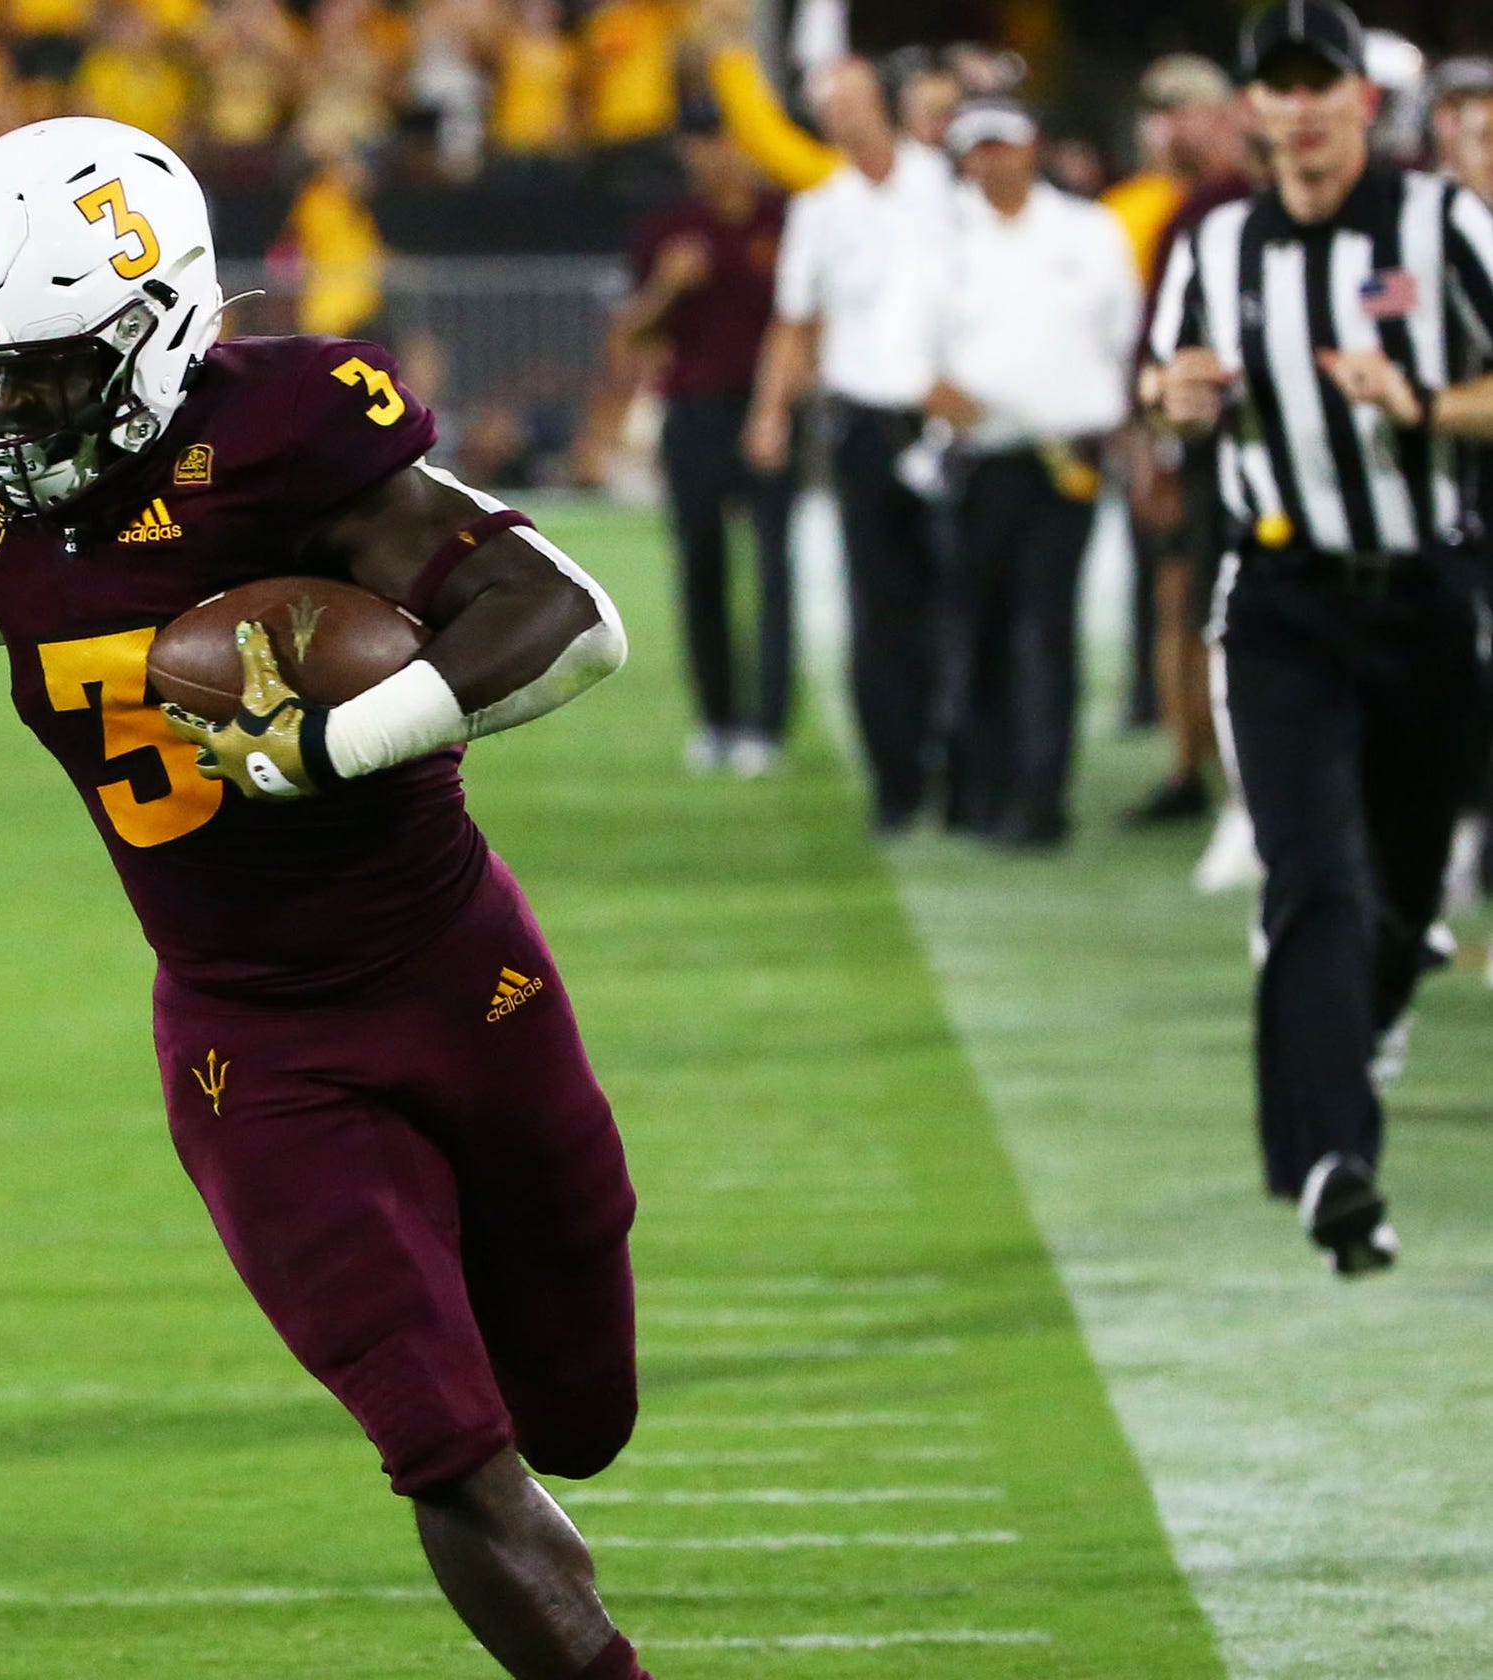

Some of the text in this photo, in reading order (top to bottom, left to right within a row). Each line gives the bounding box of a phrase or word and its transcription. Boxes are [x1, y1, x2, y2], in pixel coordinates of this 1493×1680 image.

[73, 177, 161, 281] 3
[330, 356, 406, 427] 3
[117, 523, 183, 543] adidas
[37, 626, 224, 849] 3
[486, 976, 544, 1022] adidas
